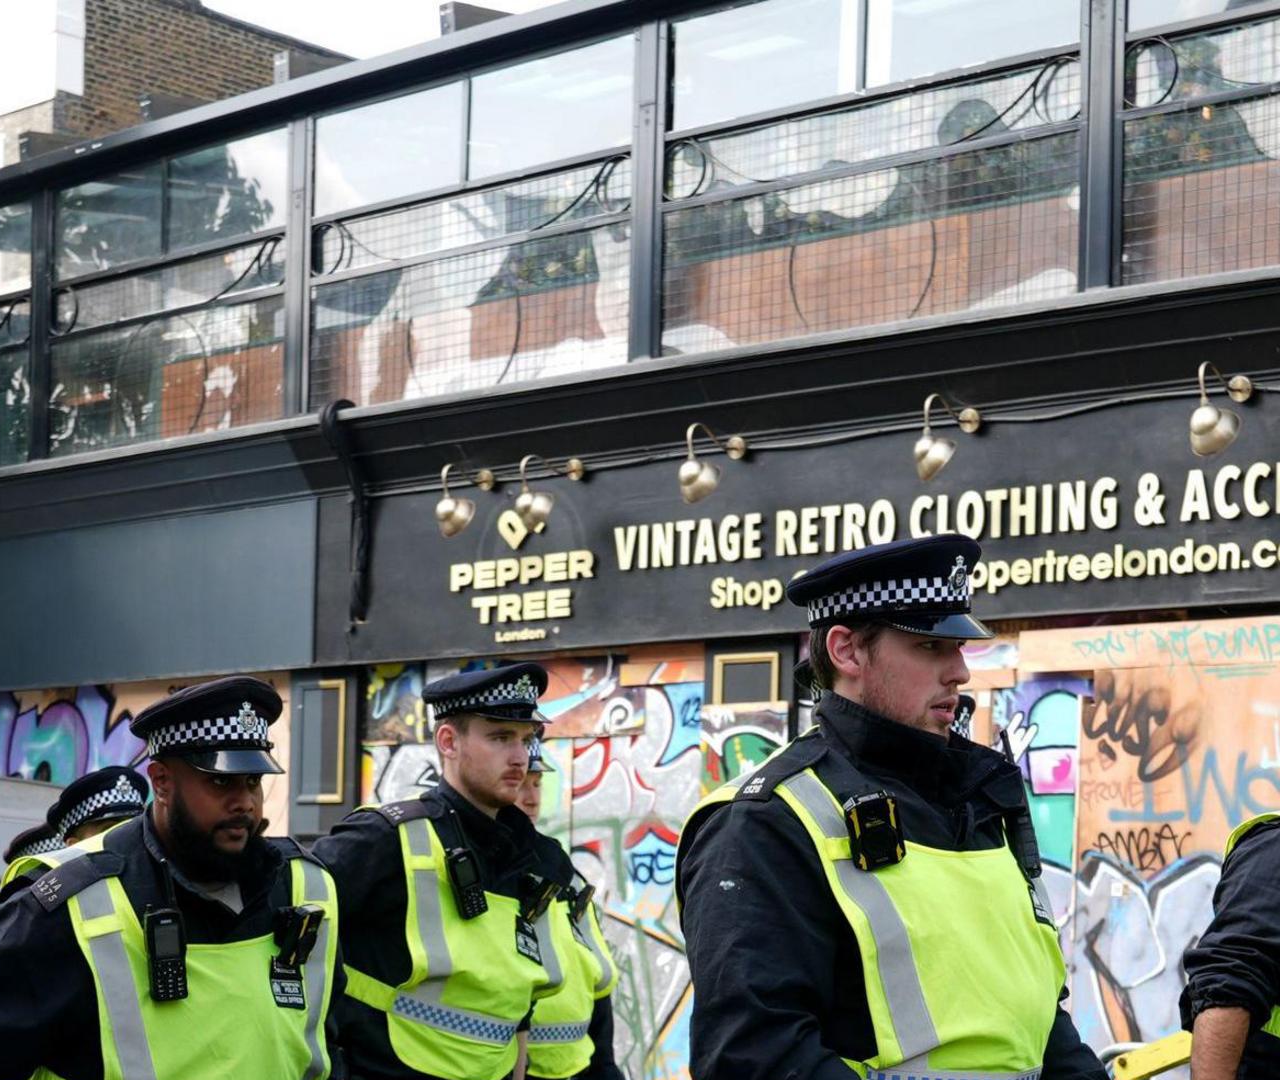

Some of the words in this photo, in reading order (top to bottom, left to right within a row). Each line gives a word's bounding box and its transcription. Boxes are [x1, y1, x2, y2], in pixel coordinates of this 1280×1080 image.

[614, 512, 762, 572] VINTAGE
[776, 498, 896, 557] RETRO
[909, 475, 1118, 542] CLOTHING
[1134, 472, 1166, 527] &
[449, 549, 594, 593] PEPPER
[471, 588, 572, 625] TREE
[710, 575, 783, 610] Shop
[495, 627, 547, 643] London
